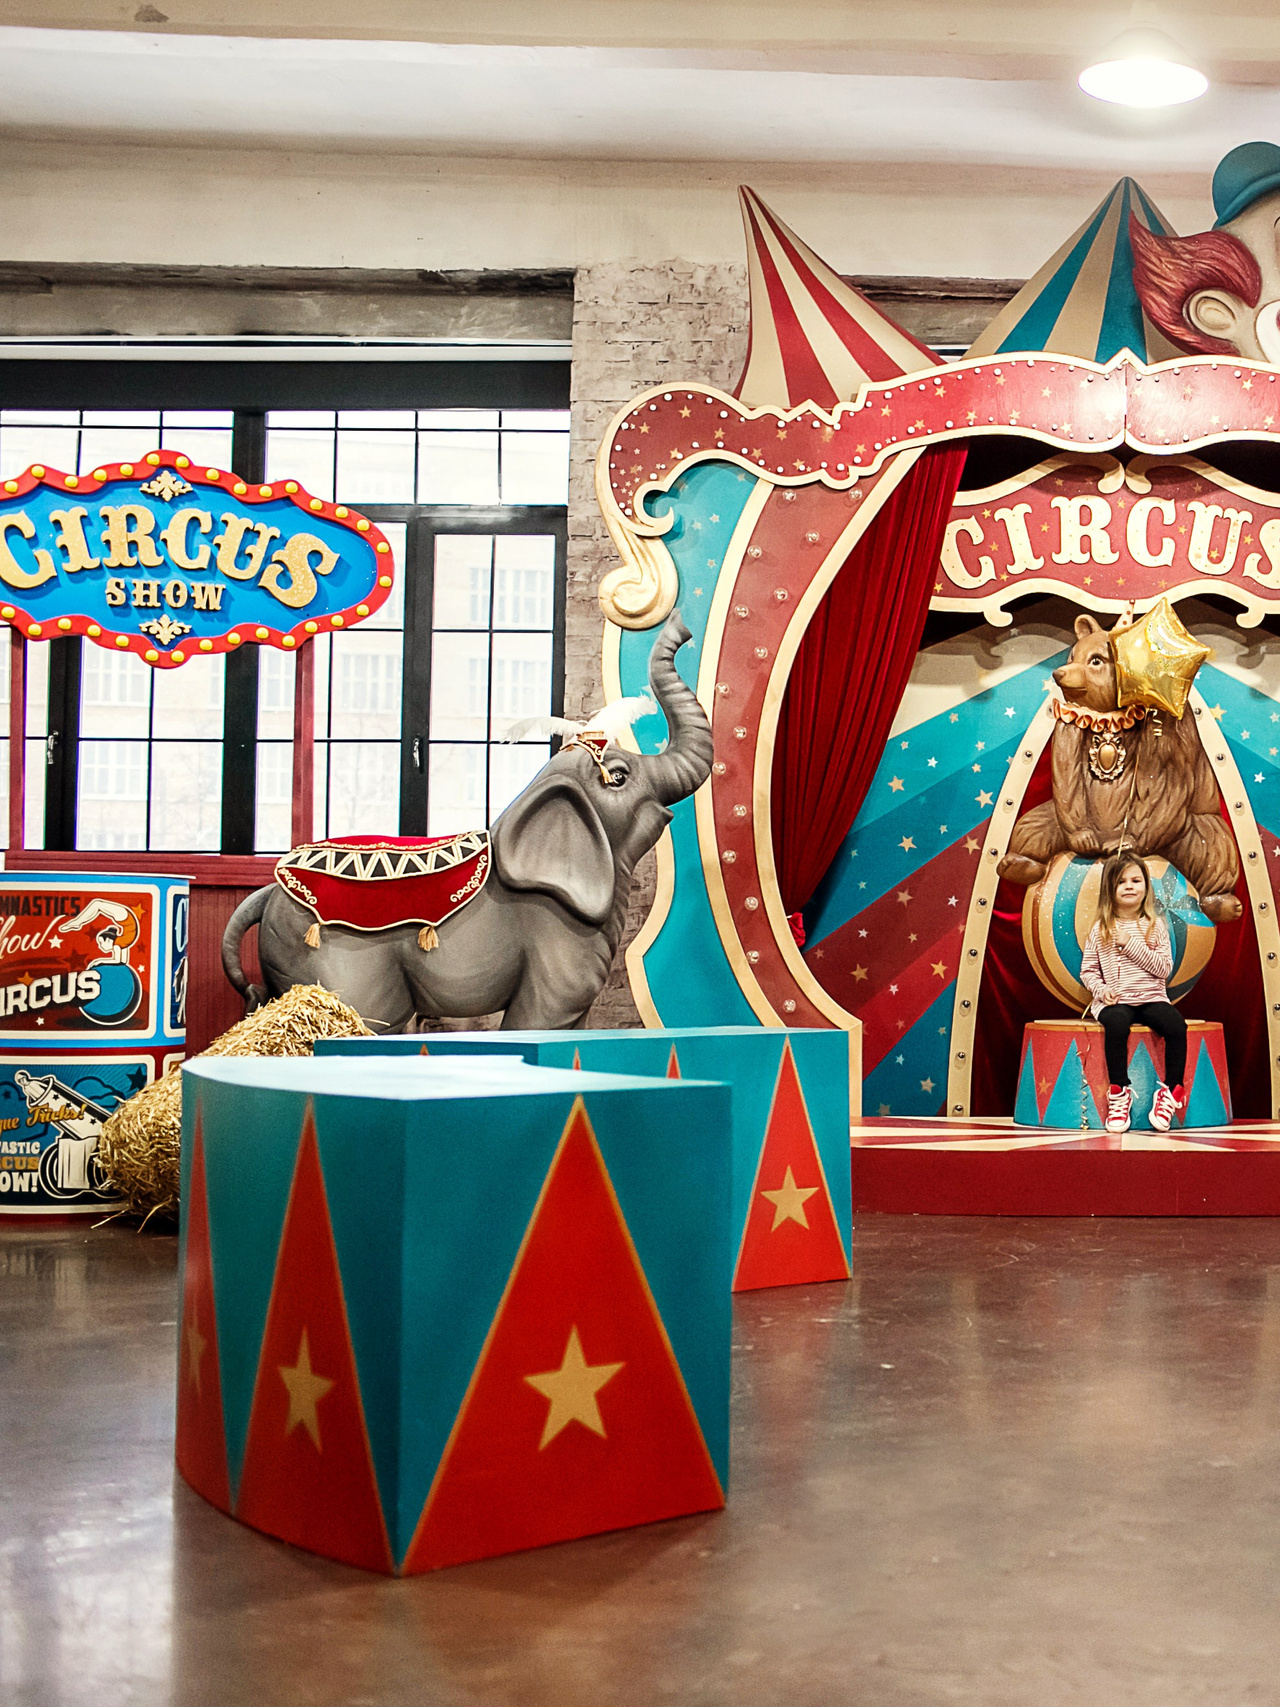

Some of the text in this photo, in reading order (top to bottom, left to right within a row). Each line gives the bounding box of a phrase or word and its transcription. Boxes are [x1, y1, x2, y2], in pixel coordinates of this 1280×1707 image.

[0, 504, 340, 608] CIRCUS
[105, 578, 226, 611] SHOW
[26, 1103, 87, 1127] Tricks!
[0, 1141, 41, 1155] ASTIC
